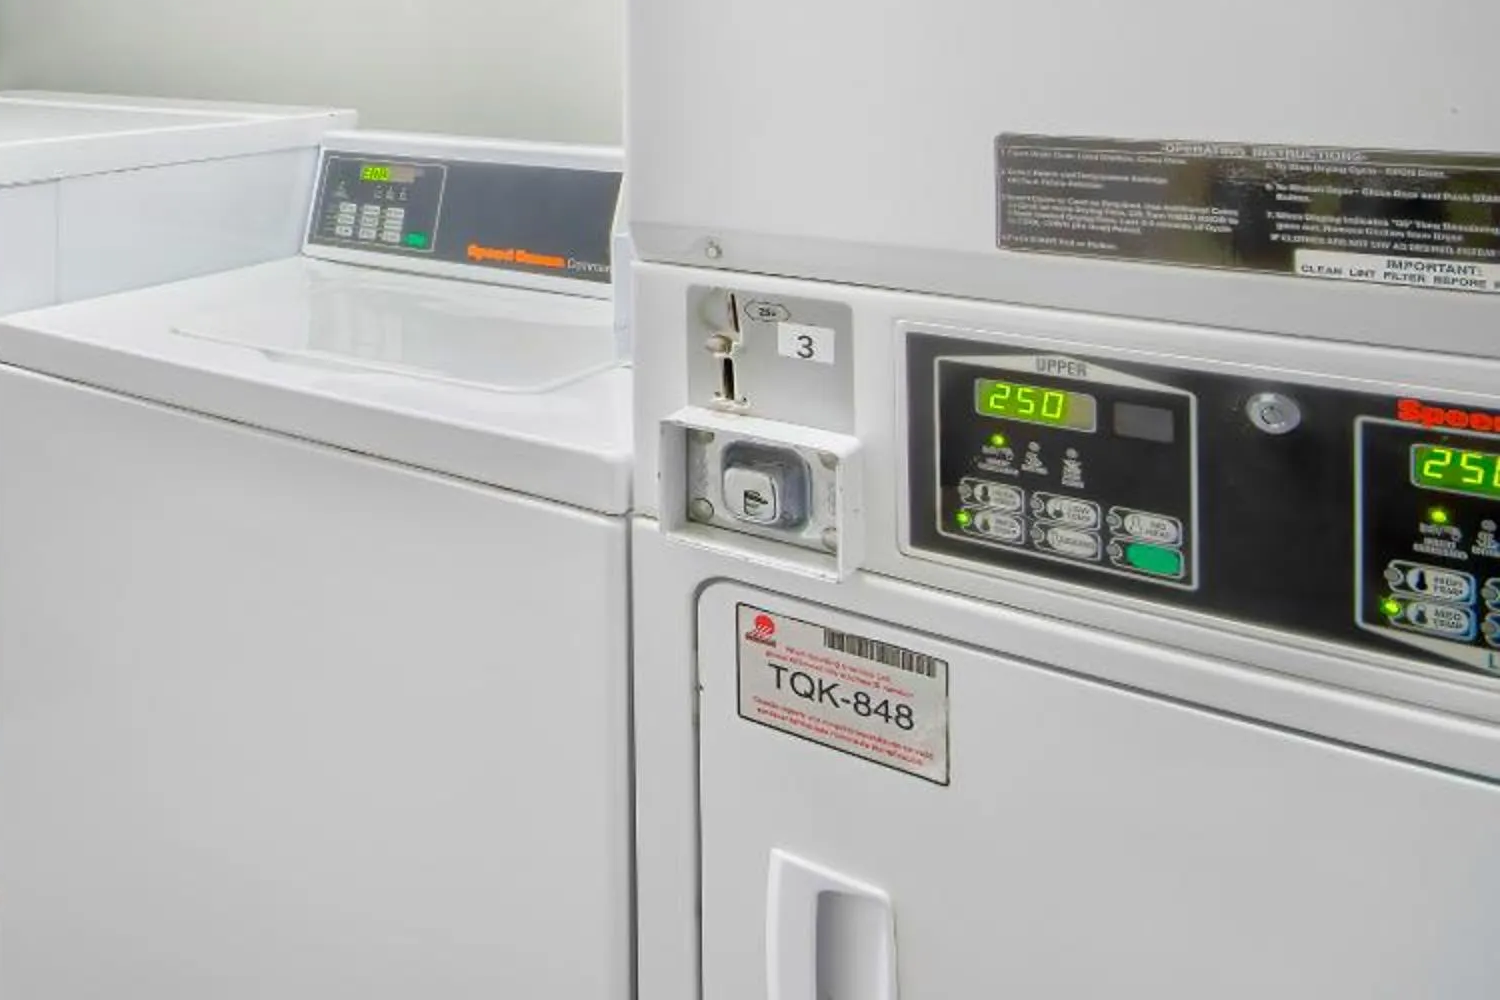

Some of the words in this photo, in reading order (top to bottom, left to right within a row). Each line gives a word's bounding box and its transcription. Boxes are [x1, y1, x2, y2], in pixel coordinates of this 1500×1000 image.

[797, 335, 815, 358] 3
[1036, 357, 1087, 377] UPPER
[989, 383, 1064, 419] 250
[1397, 398, 1500, 434] Spee
[768, 662, 915, 731] TQK-848
